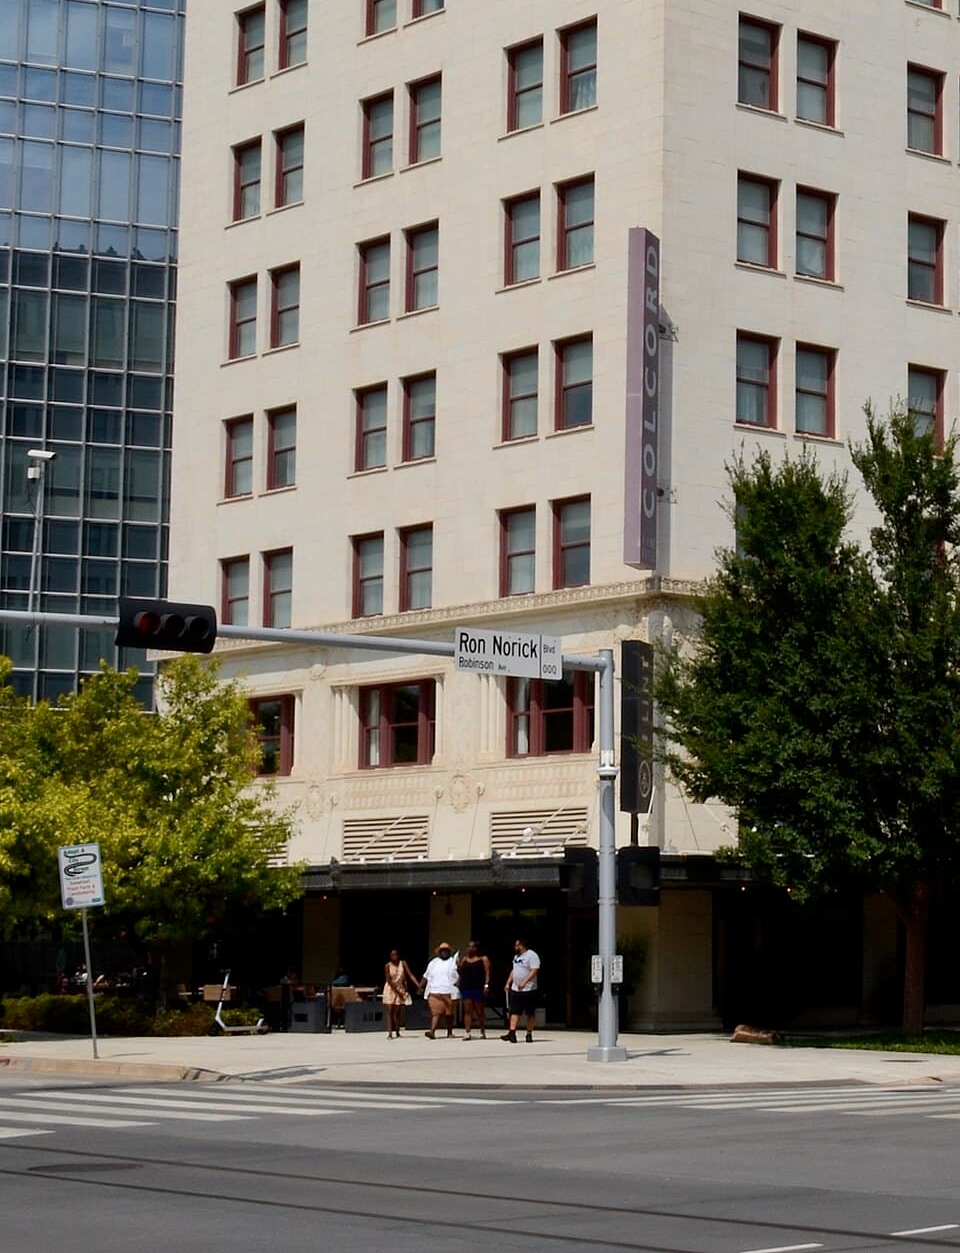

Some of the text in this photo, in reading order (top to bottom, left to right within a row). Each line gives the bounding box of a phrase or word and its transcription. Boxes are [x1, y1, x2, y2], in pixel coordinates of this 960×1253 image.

[643, 245, 659, 518] COLCORD
[459, 632, 538, 659] Ron Norick
[458, 656, 494, 669] Robinson
